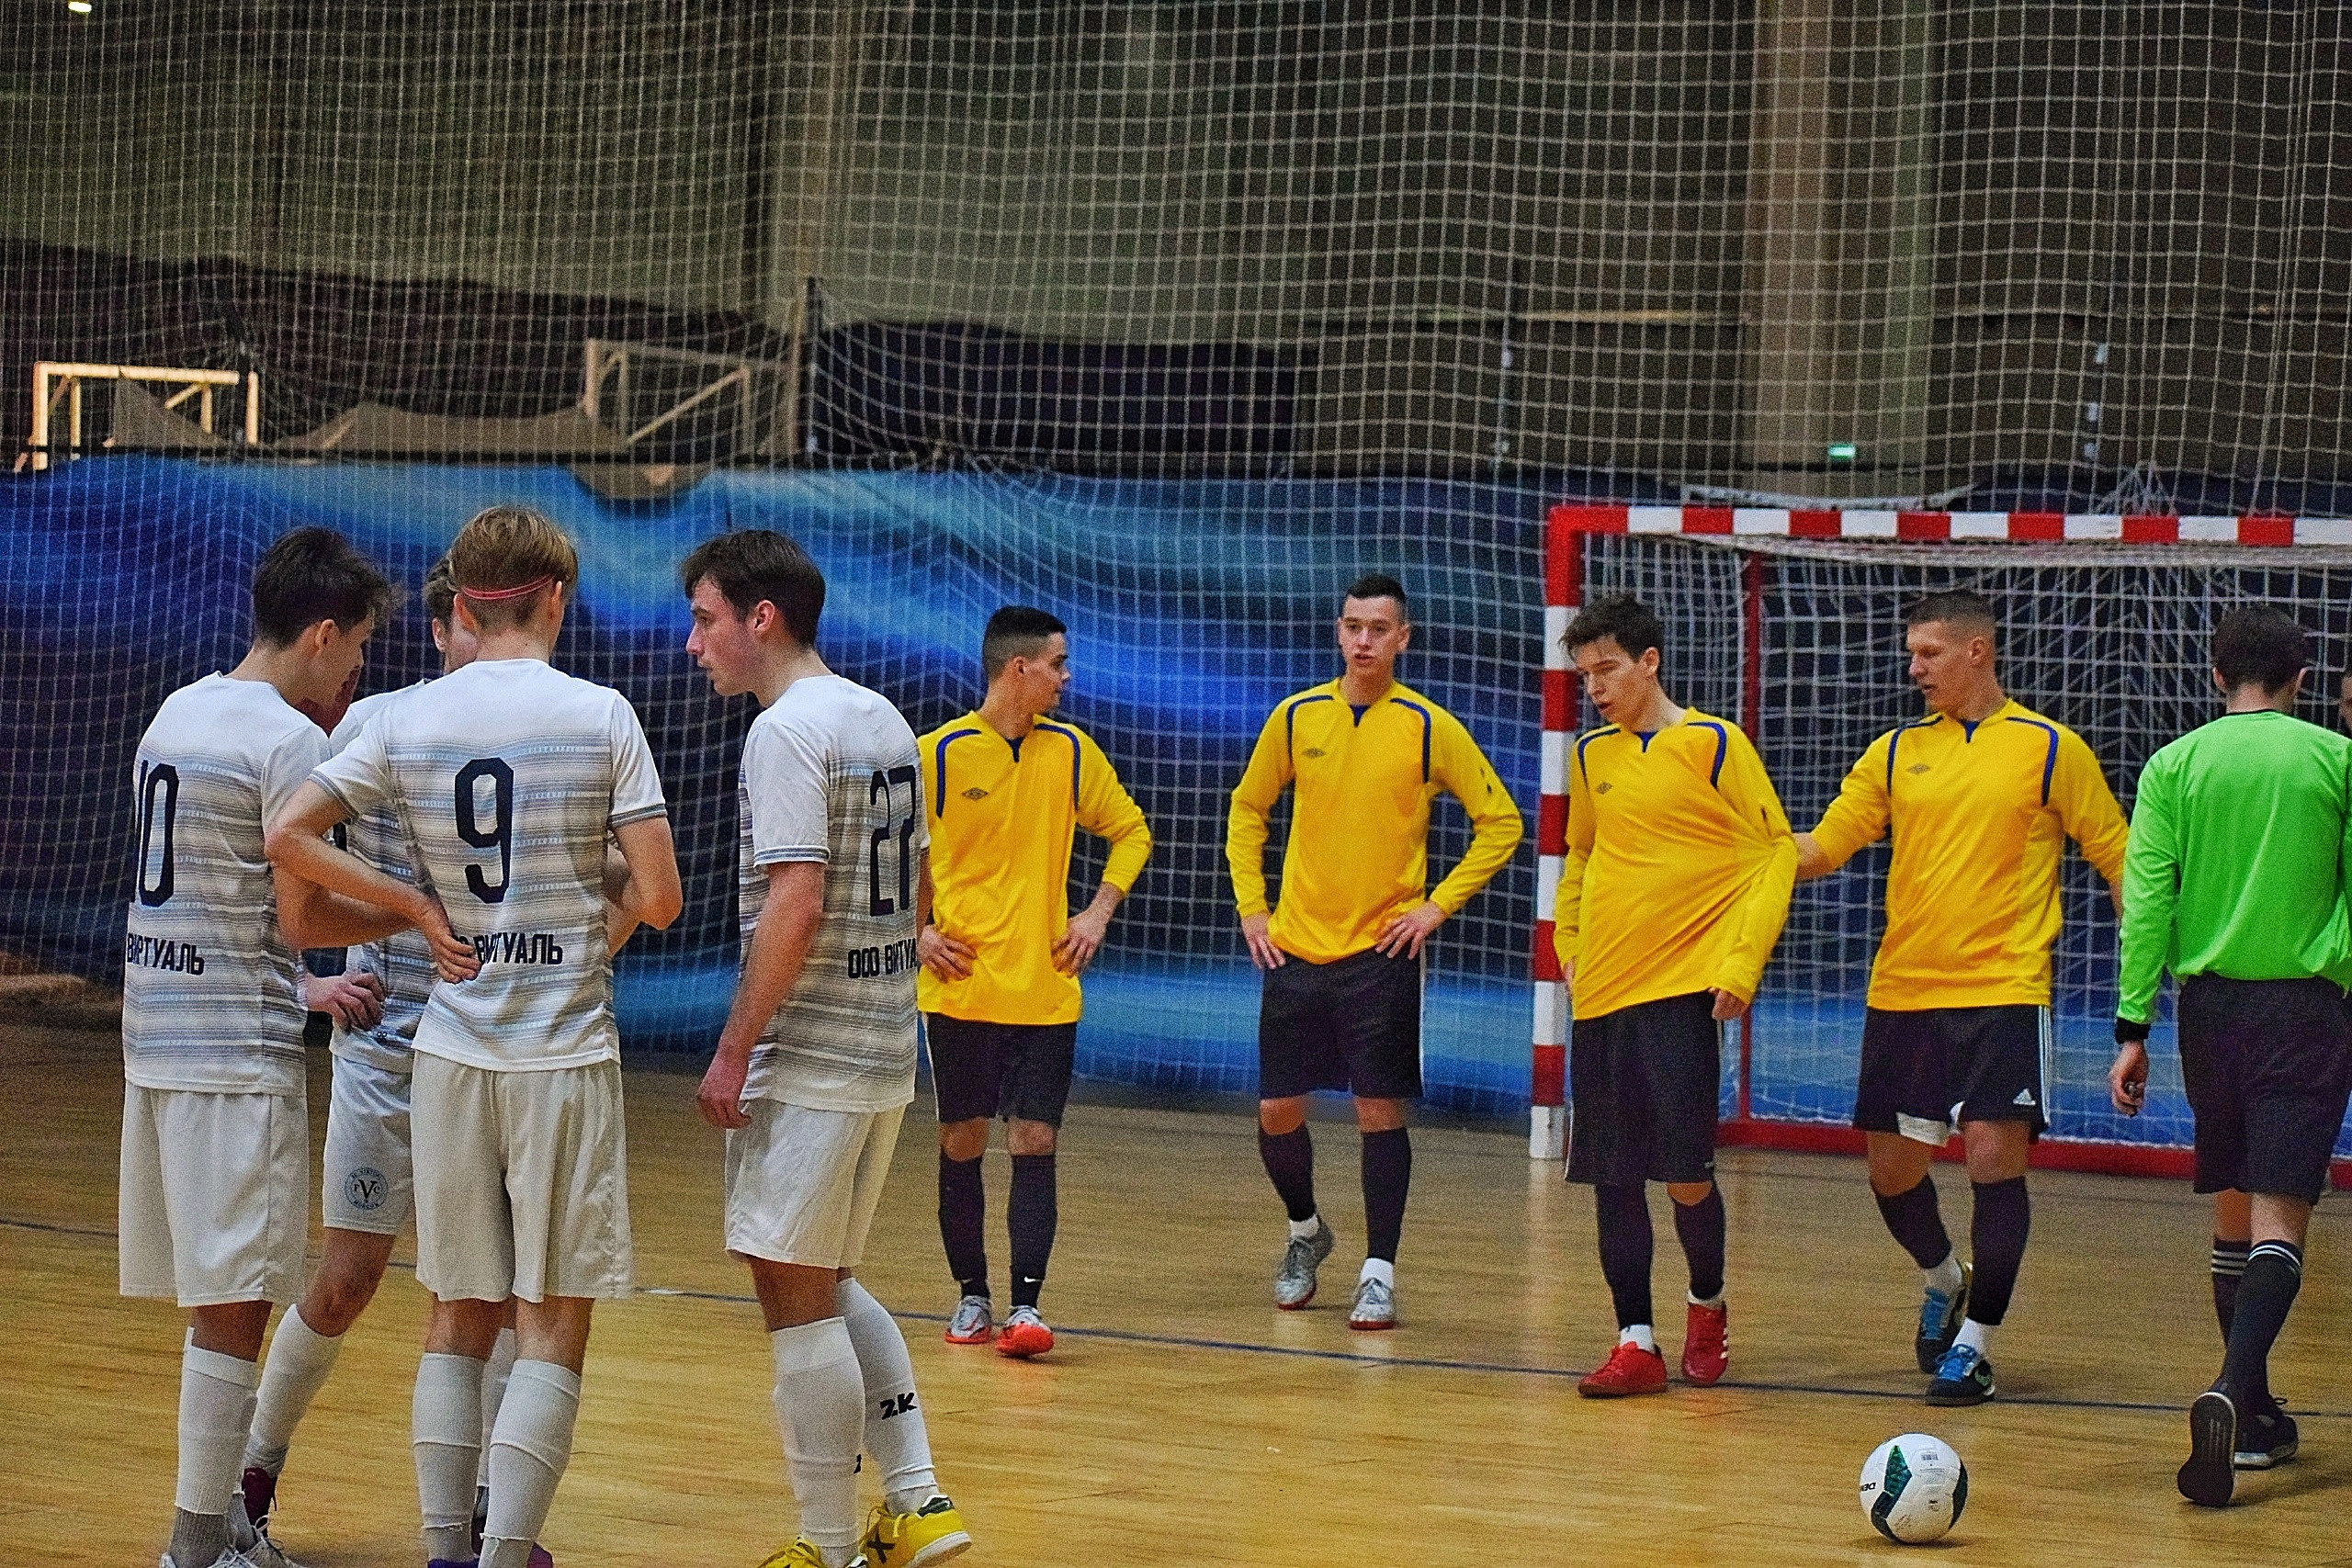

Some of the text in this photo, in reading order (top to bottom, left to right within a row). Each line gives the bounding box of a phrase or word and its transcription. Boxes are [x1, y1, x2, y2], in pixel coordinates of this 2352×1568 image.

[454, 757, 514, 904] 9
[870, 765, 917, 917] 27
[880, 1393, 917, 1420] 2K
